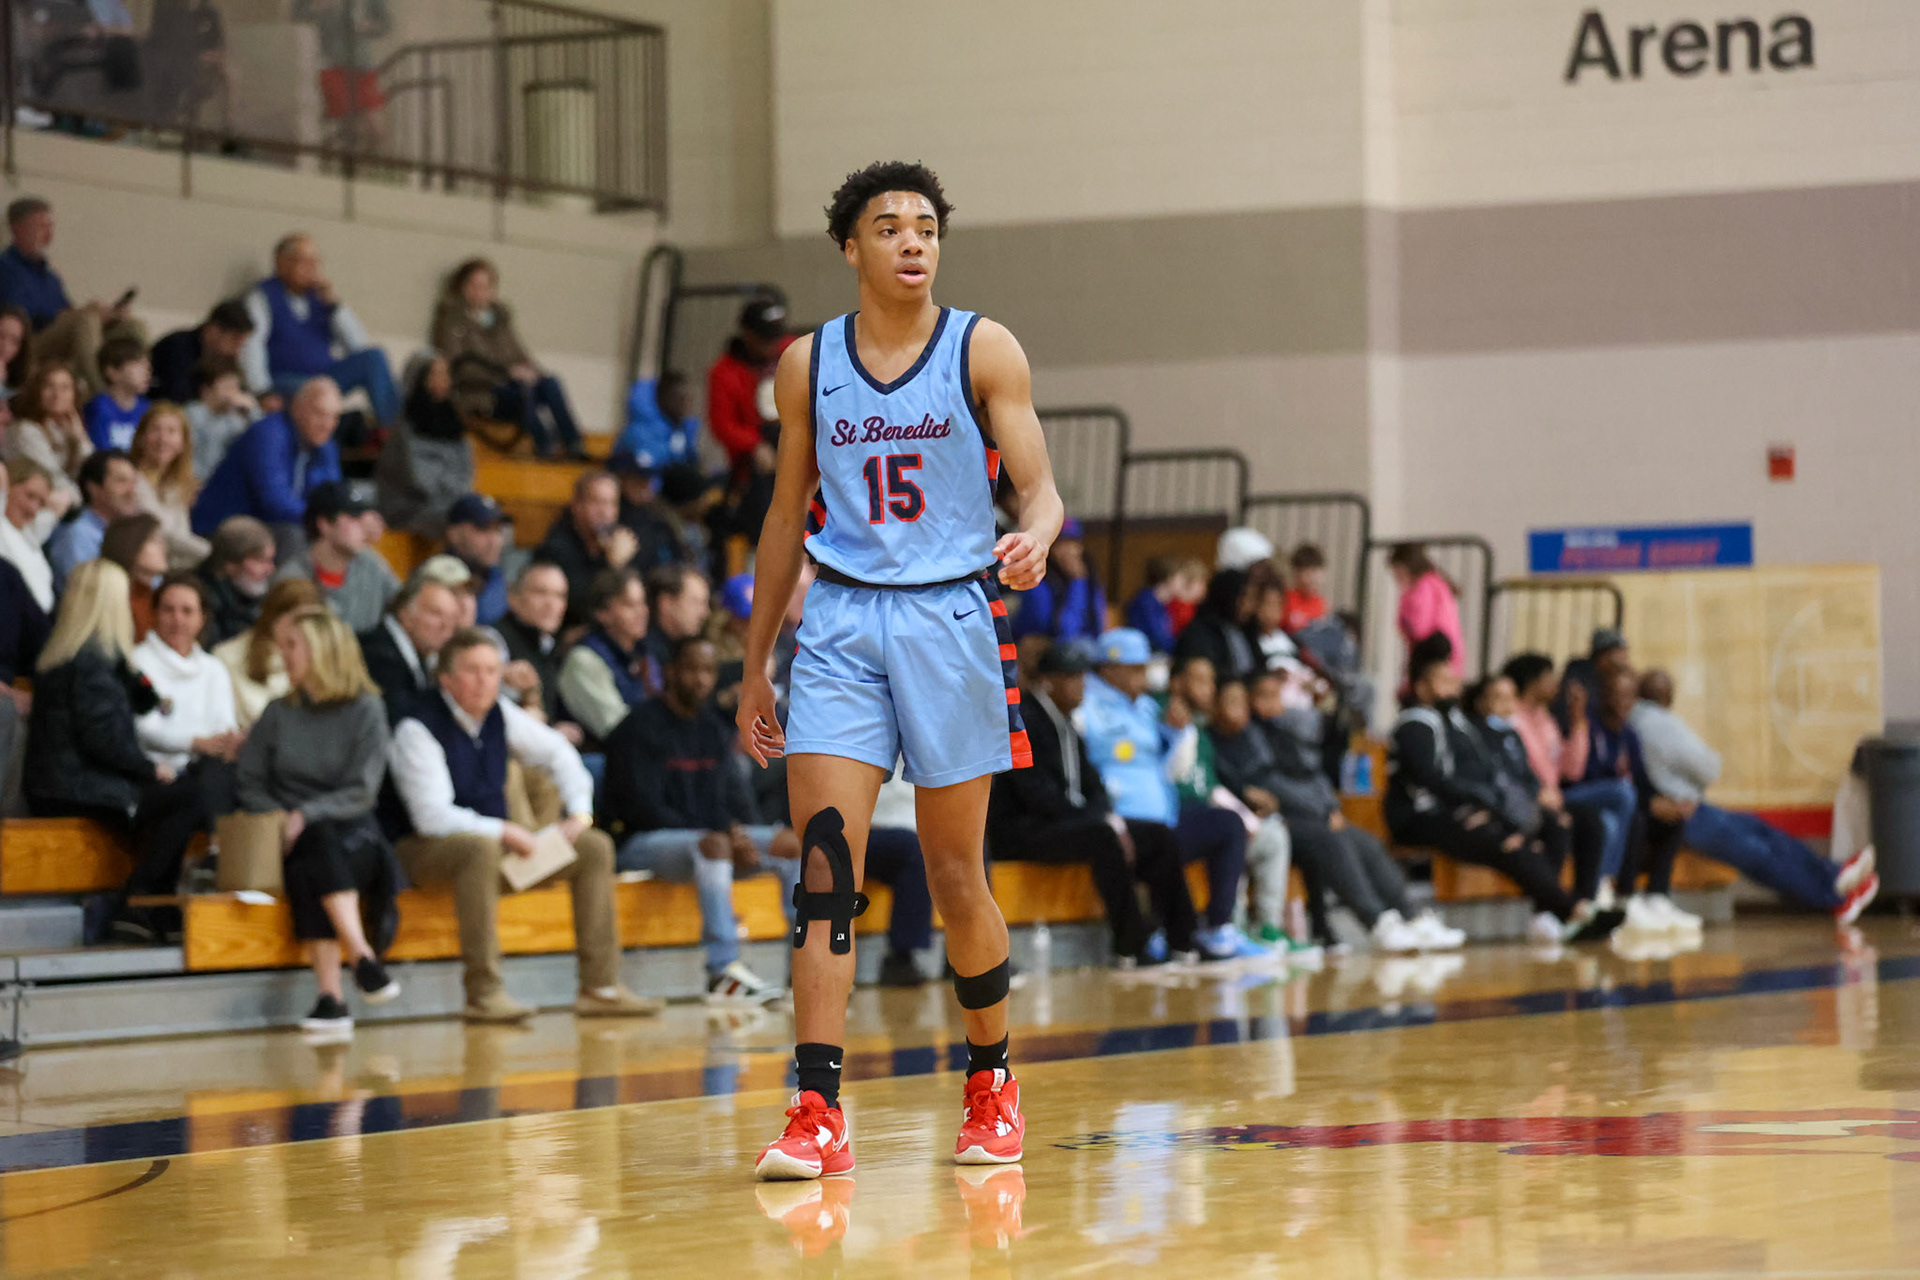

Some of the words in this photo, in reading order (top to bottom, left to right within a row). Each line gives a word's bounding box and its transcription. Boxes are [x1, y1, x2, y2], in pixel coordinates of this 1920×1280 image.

[1563, 8, 1815, 84] Arena
[830, 418, 857, 447] St
[860, 412, 951, 443] Benedict
[863, 453, 926, 524] 15
